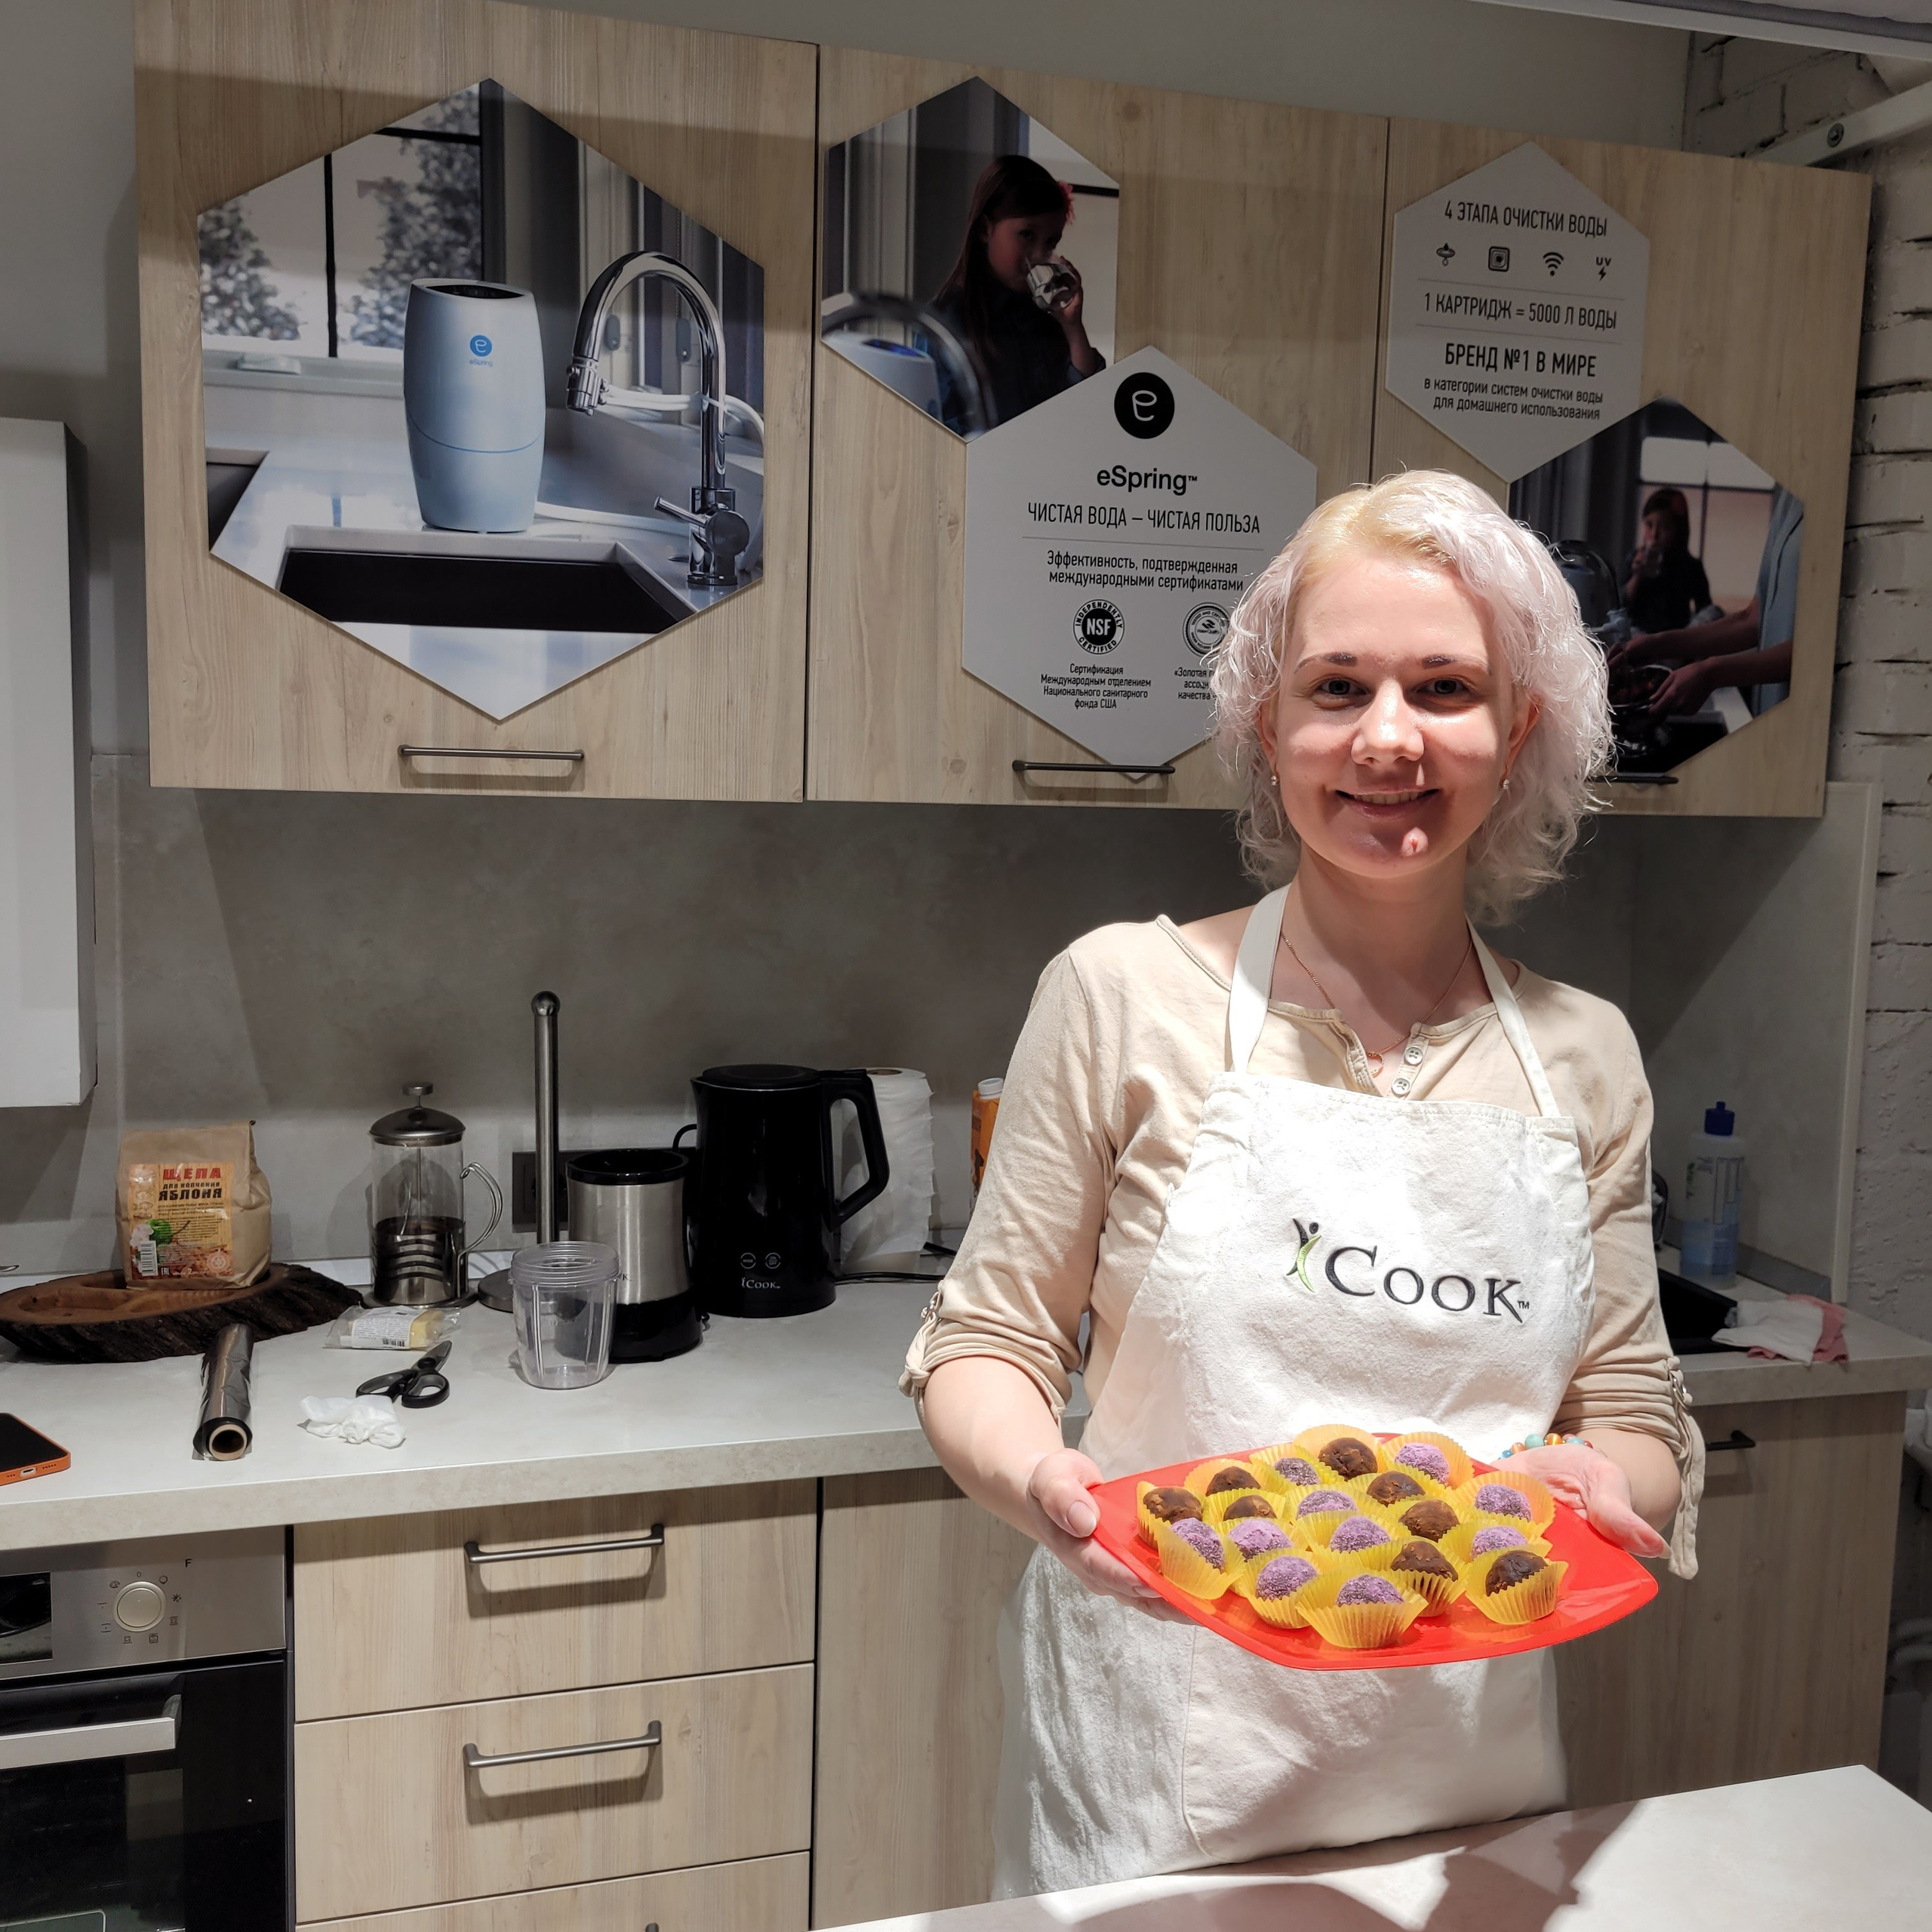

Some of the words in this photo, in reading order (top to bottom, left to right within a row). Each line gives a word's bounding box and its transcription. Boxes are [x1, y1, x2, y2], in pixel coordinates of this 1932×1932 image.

[1444, 200, 1453, 220] 4
[1457, 202, 1499, 225] ЭТАПА
[1503, 207, 1564, 232] ОЧИСТКИ
[1568, 214, 1607, 238] ВОДЫ
[1595, 256, 1612, 266] UV
[1424, 292, 1430, 312] 1
[1435, 294, 1512, 321] КАРТРИДЖ
[1528, 303, 1561, 324] 5000
[1564, 306, 1574, 325] Л
[1578, 307, 1617, 331] ВОДЫ
[1444, 343, 1498, 373] БРЕНД
[1503, 347, 1529, 371] №1
[1536, 350, 1546, 373] В
[1552, 352, 1597, 377] МИРЕ
[1424, 377, 1431, 389] в
[1433, 379, 1488, 397] категории
[1491, 383, 1528, 398] систем
[1531, 386, 1574, 401] очистки
[1576, 390, 1604, 405] воды
[1433, 396, 1454, 411] для
[1457, 398, 1518, 415] домашнего
[1521, 403, 1601, 420] использования
[1028, 501, 1084, 525] ЧИСТАЯ
[1088, 505, 1128, 529] ВОДА
[1147, 509, 1201, 531] ЧИСТАЯ
[1205, 512, 1260, 534] ПОЛЬЗА
[1047, 550, 1139, 571] Эффективность,
[1142, 557, 1238, 575] подтвержденная
[1049, 571, 1155, 589] международными
[1158, 575, 1244, 593] сертификатами
[1075, 601, 1123, 629] INDEPENDENTLY
[1087, 617, 1112, 636] NSF
[1078, 636, 1117, 654] CERTIFIED
[1069, 663, 1124, 676] Сертификация
[1041, 673, 1106, 688] Международным
[1107, 678, 1152, 688] отделением
[1043, 685, 1101, 697] Национального
[1103, 689, 1149, 700] санитарного
[1178, 691, 1211, 700] качества
[1075, 698, 1099, 710] фонда
[1100, 698, 1118, 709] США
[163, 1168, 222, 1182] ЩЕПА
[158, 1188, 222, 1201] ЯБЛОНЯ
[185, 1558, 192, 1567] F
